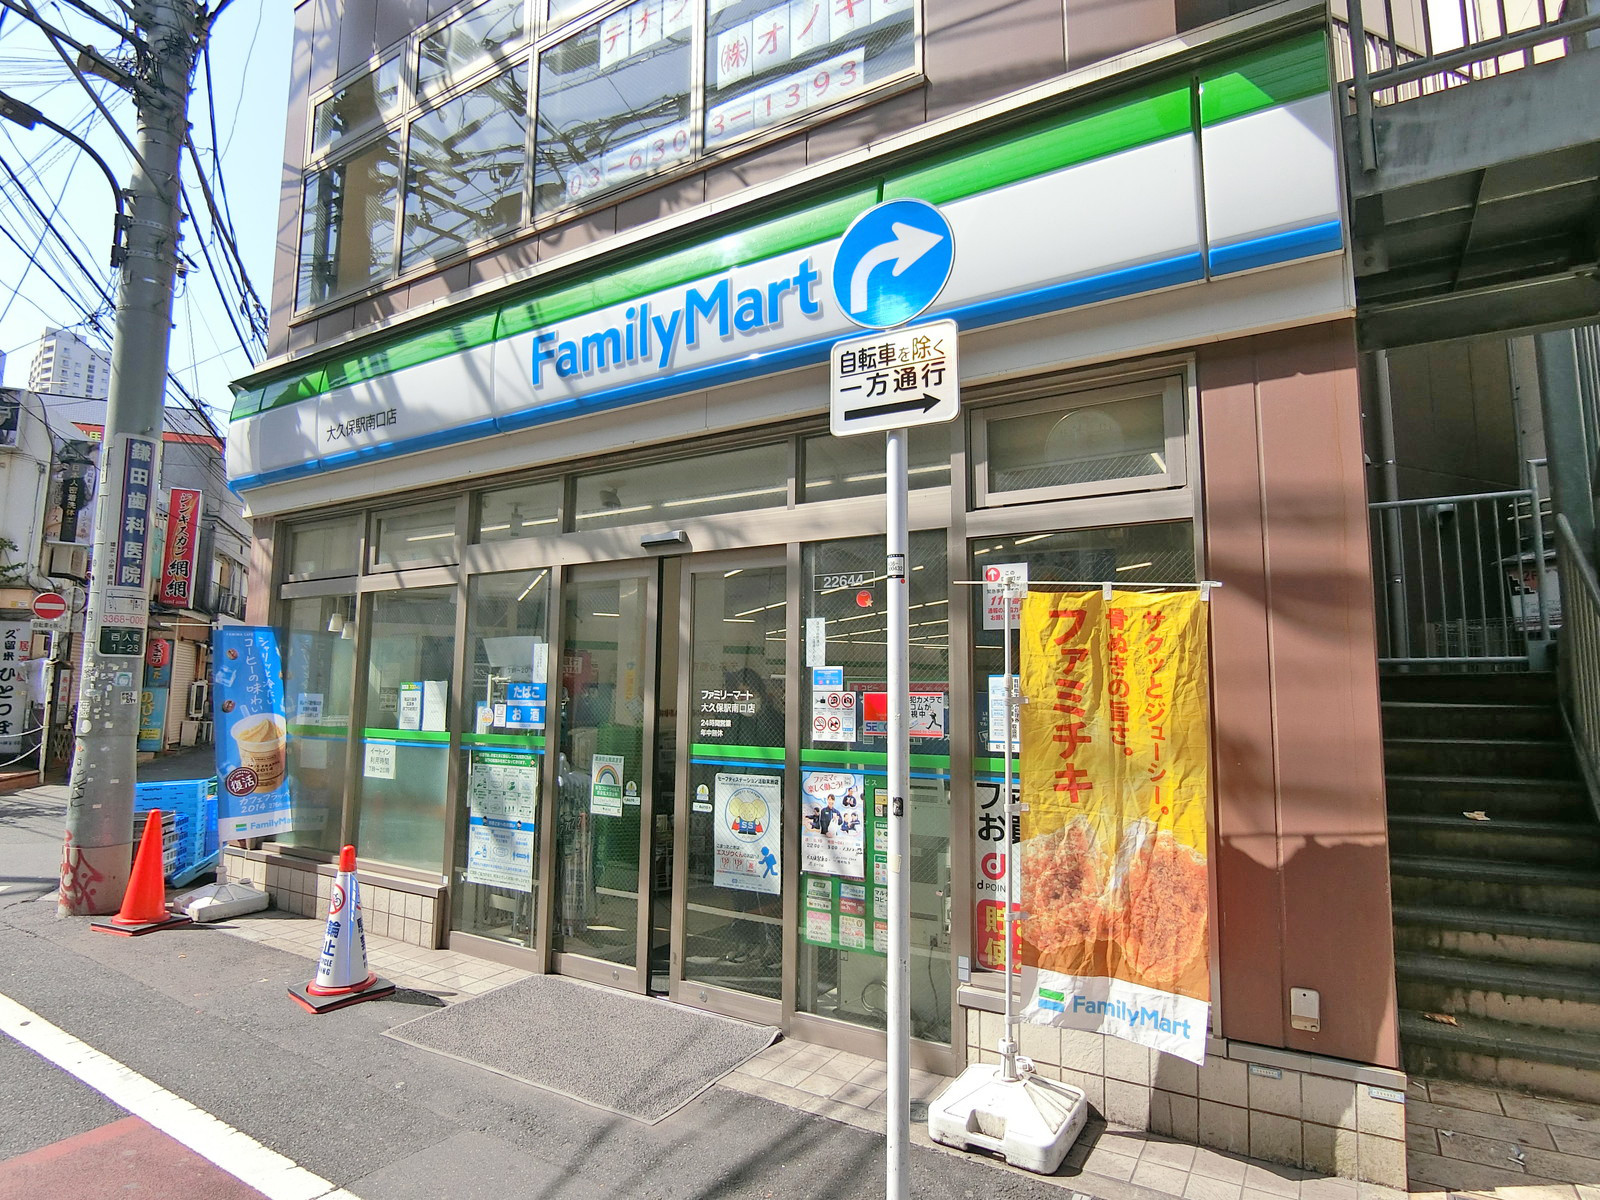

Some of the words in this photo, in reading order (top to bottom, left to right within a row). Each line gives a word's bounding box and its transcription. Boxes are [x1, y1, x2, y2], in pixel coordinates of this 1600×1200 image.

[532, 257, 820, 386] FamilyMart
[840, 335, 945, 375] 自転車を除く
[840, 361, 946, 398] 一方通行
[326, 408, 397, 442] 大久保駅南口店
[121, 442, 151, 585] 鎌田歯科医院
[175, 492, 193, 556] ジンギスカン
[165, 559, 190, 598] 網網
[823, 574, 864, 589] 22644
[103, 614, 145, 625] 3368-009
[111, 643, 139, 653] 1-23
[244, 638, 263, 713] コーヒーの味わい
[1106, 608, 1133, 756] 骨ぬきの旨さ。
[513, 686, 540, 698] たばこ
[701, 690, 753, 701] ファミリーマート
[701, 702, 755, 713] 大久保駅南口店
[909, 696, 942, 704] 犯カメラで
[910, 703, 931, 711] コムが
[1049, 609, 1093, 803] ファミチキ
[512, 707, 540, 721] お酒
[1142, 610, 1170, 815] サクッとジューシー。
[866, 722, 888, 732] SEC
[371, 748, 390, 756] イートイン
[370, 757, 390, 765] 利用時間
[231, 775, 255, 793] 復活
[241, 803, 266, 813] 2014
[985, 883, 1006, 892] POIN
[1072, 995, 1190, 1040] FamilyMart
